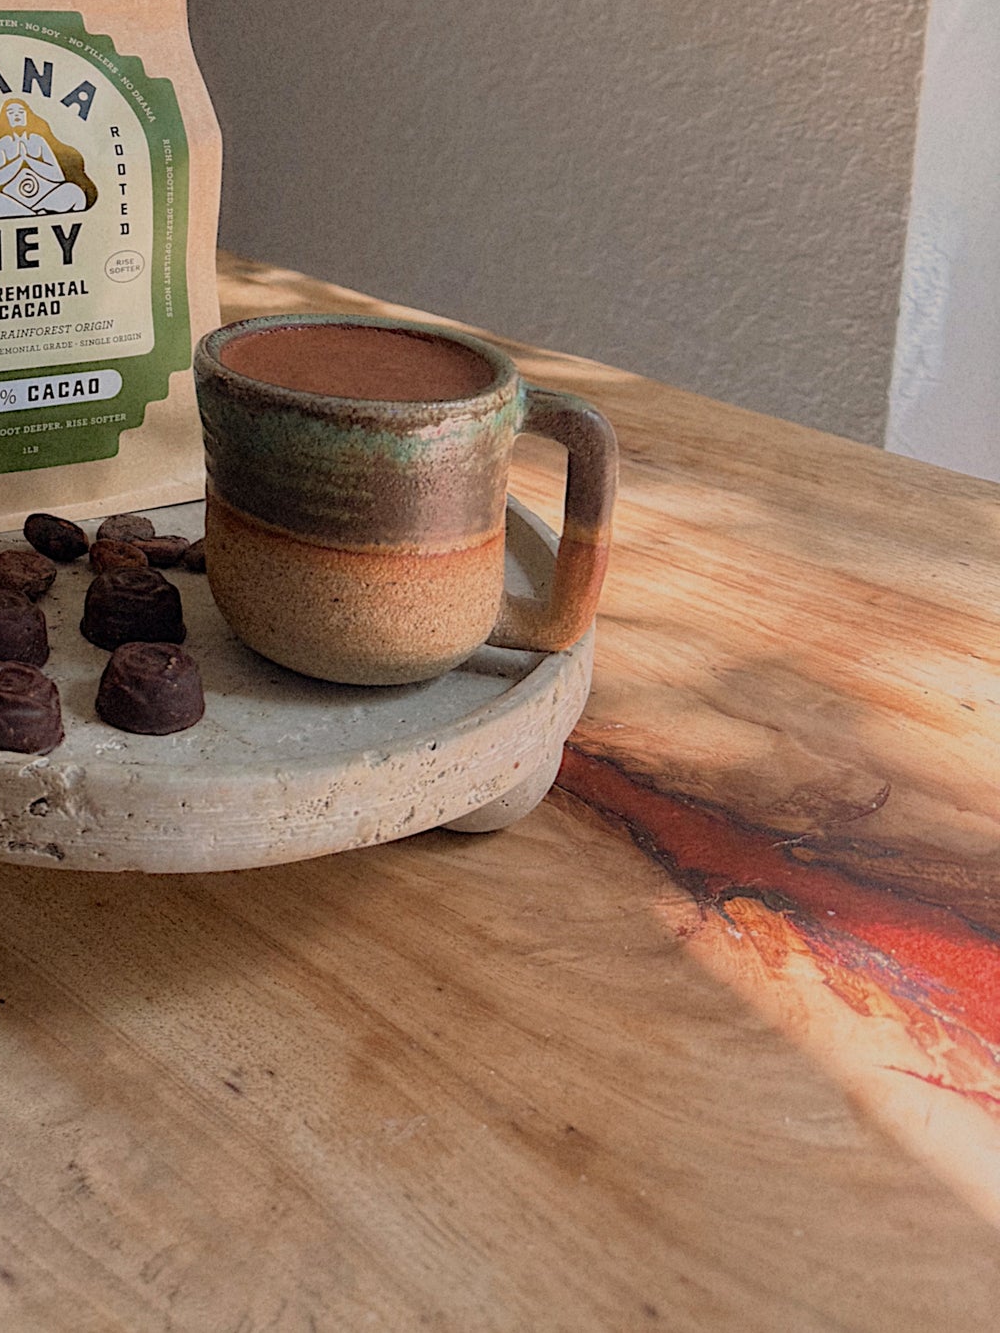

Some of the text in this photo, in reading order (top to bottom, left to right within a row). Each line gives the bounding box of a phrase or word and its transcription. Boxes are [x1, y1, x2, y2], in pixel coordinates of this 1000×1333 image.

[25, 23, 40, 32] NO
[41, 27, 61, 39] SOY
[68, 38, 84, 48] NO
[83, 43, 119, 74] FILLERS
[120, 76, 134, 90] NO
[132, 89, 157, 123] DRAMA
[110, 126, 130, 235] ROOTED
[165, 208, 174, 241] DEEPLY
[109, 266, 141, 275] SOFTER
[116, 258, 135, 266] RISE
[163, 243, 174, 285] OPULENT
[163, 287, 173, 318] NOTES
[0, 324, 72, 341] RAINFOREST
[74, 319, 115, 333] ORIGIN
[43, 341, 73, 351] GRADE
[79, 337, 111, 347] SINGLE
[112, 333, 142, 343] ORIGIN
[27, 378, 100, 402] CACAO
[23, 422, 64, 434] DEEPER.
[66, 418, 88, 429] RISE
[90, 414, 127, 425] SOFTER
[22, 446, 39, 455] 1LB
